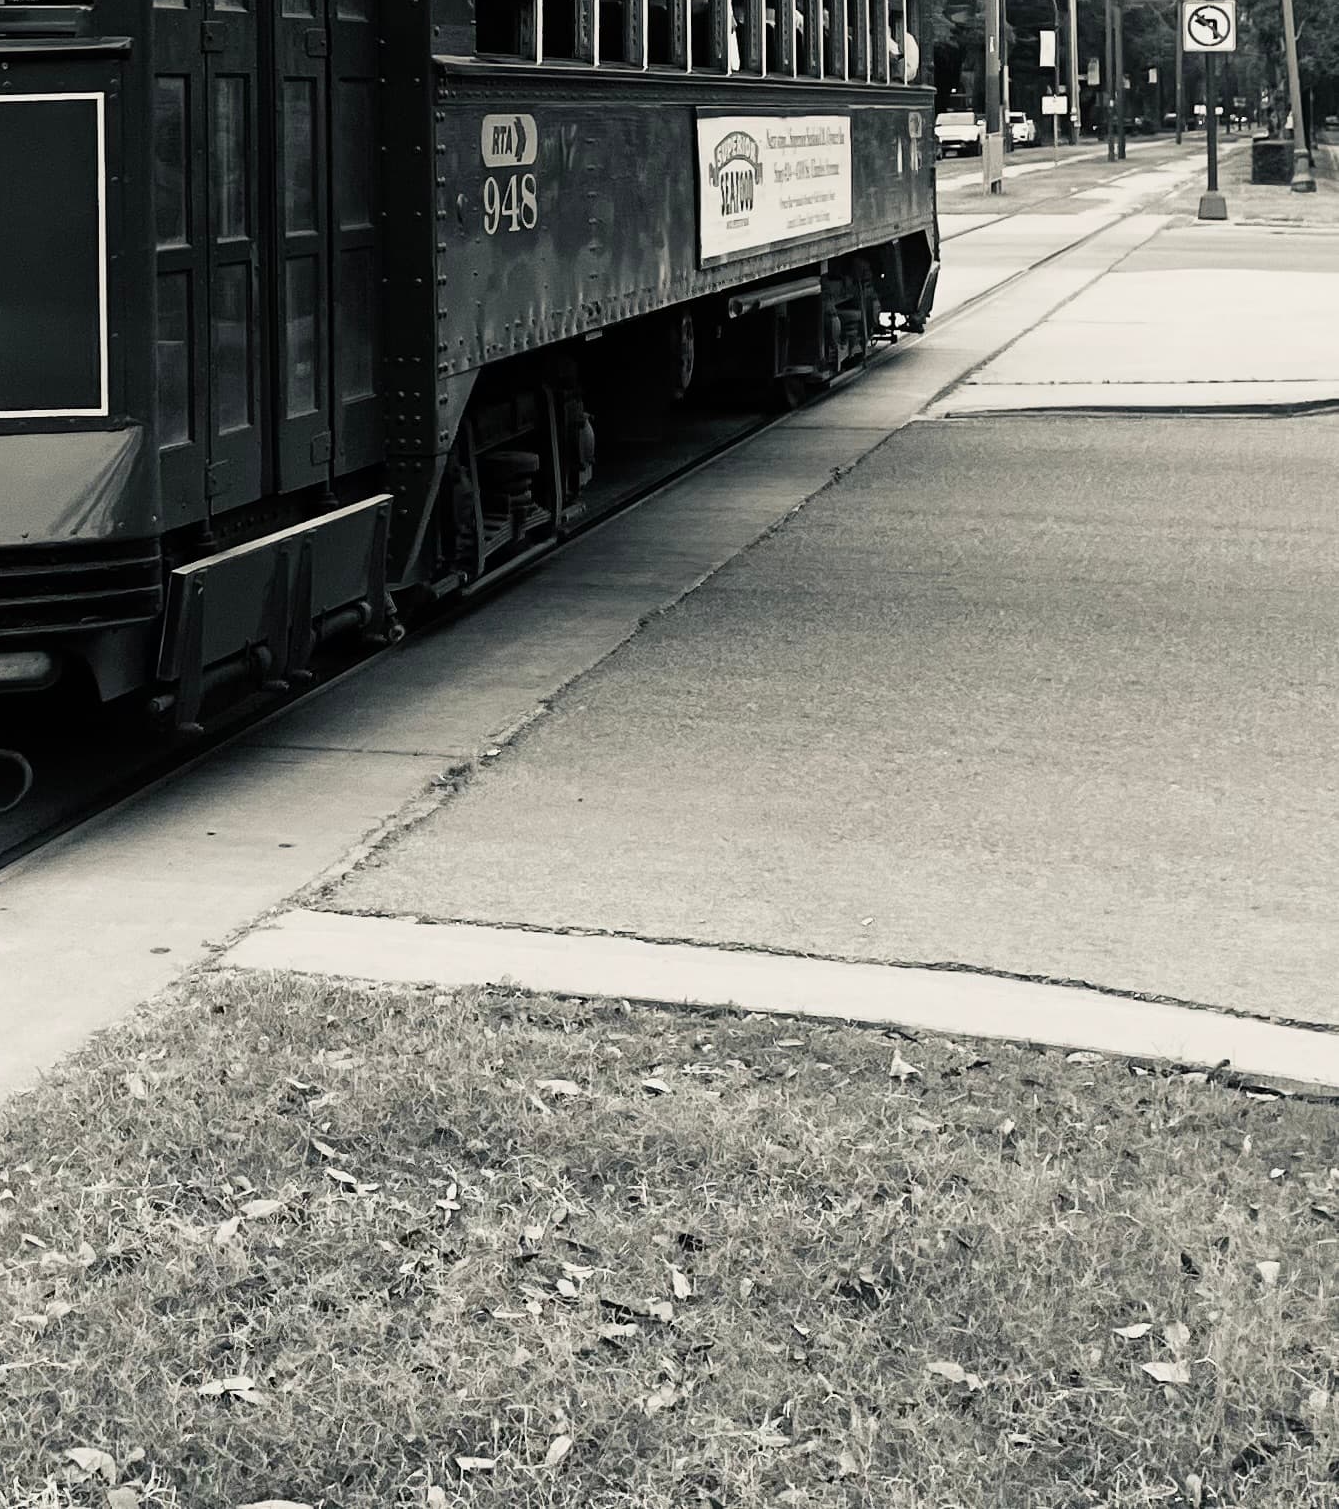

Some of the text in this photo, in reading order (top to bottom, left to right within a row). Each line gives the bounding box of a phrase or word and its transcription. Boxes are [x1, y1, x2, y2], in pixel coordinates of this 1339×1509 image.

[492, 126, 512, 155] RTA
[483, 173, 538, 235] 948
[720, 170, 754, 217] SEAFOOD
